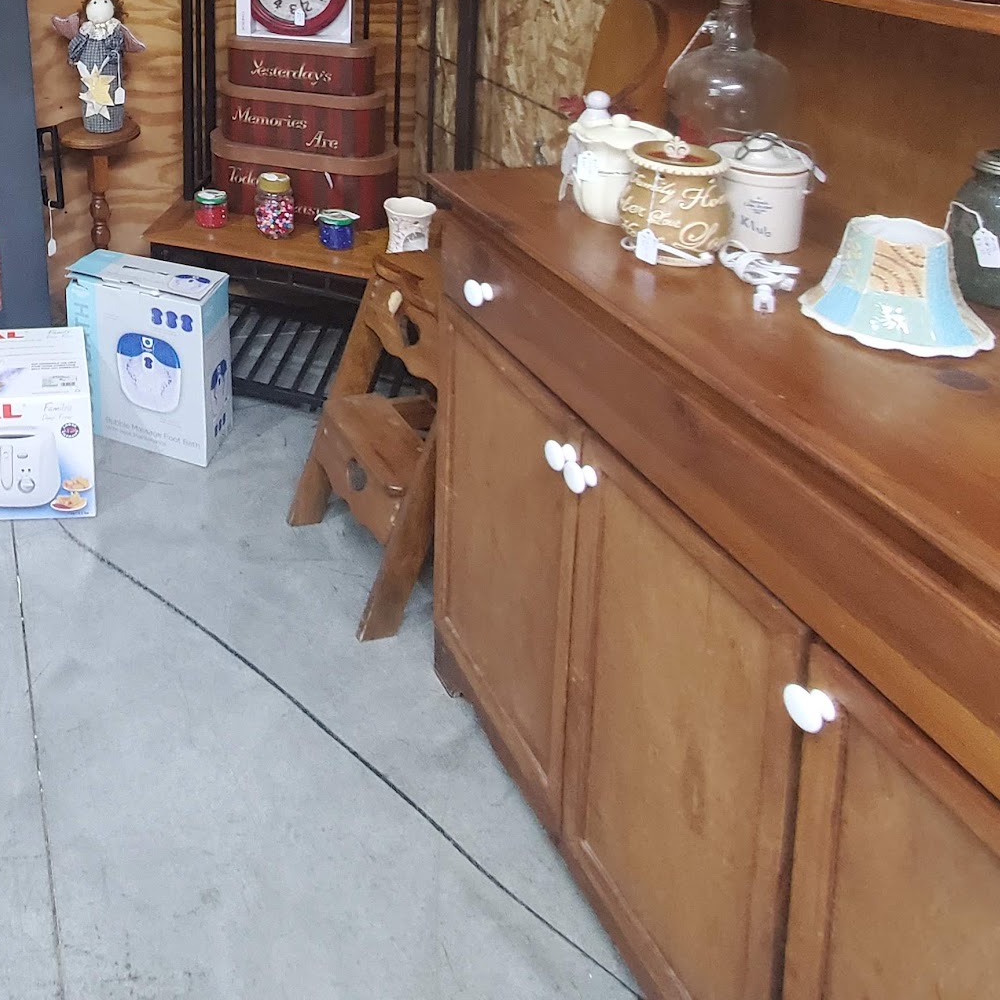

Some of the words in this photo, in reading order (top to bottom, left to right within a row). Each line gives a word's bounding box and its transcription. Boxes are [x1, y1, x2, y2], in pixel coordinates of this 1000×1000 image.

[273, 0, 283, 9] 4
[301, 0, 312, 12] 2
[250, 60, 332, 86] Yesterday's
[232, 106, 308, 130] Memories
[305, 130, 339, 149] Are
[740, 214, 772, 238] Klub
[163, 433, 180, 443] Foot
[183, 439, 201, 449] Bath
